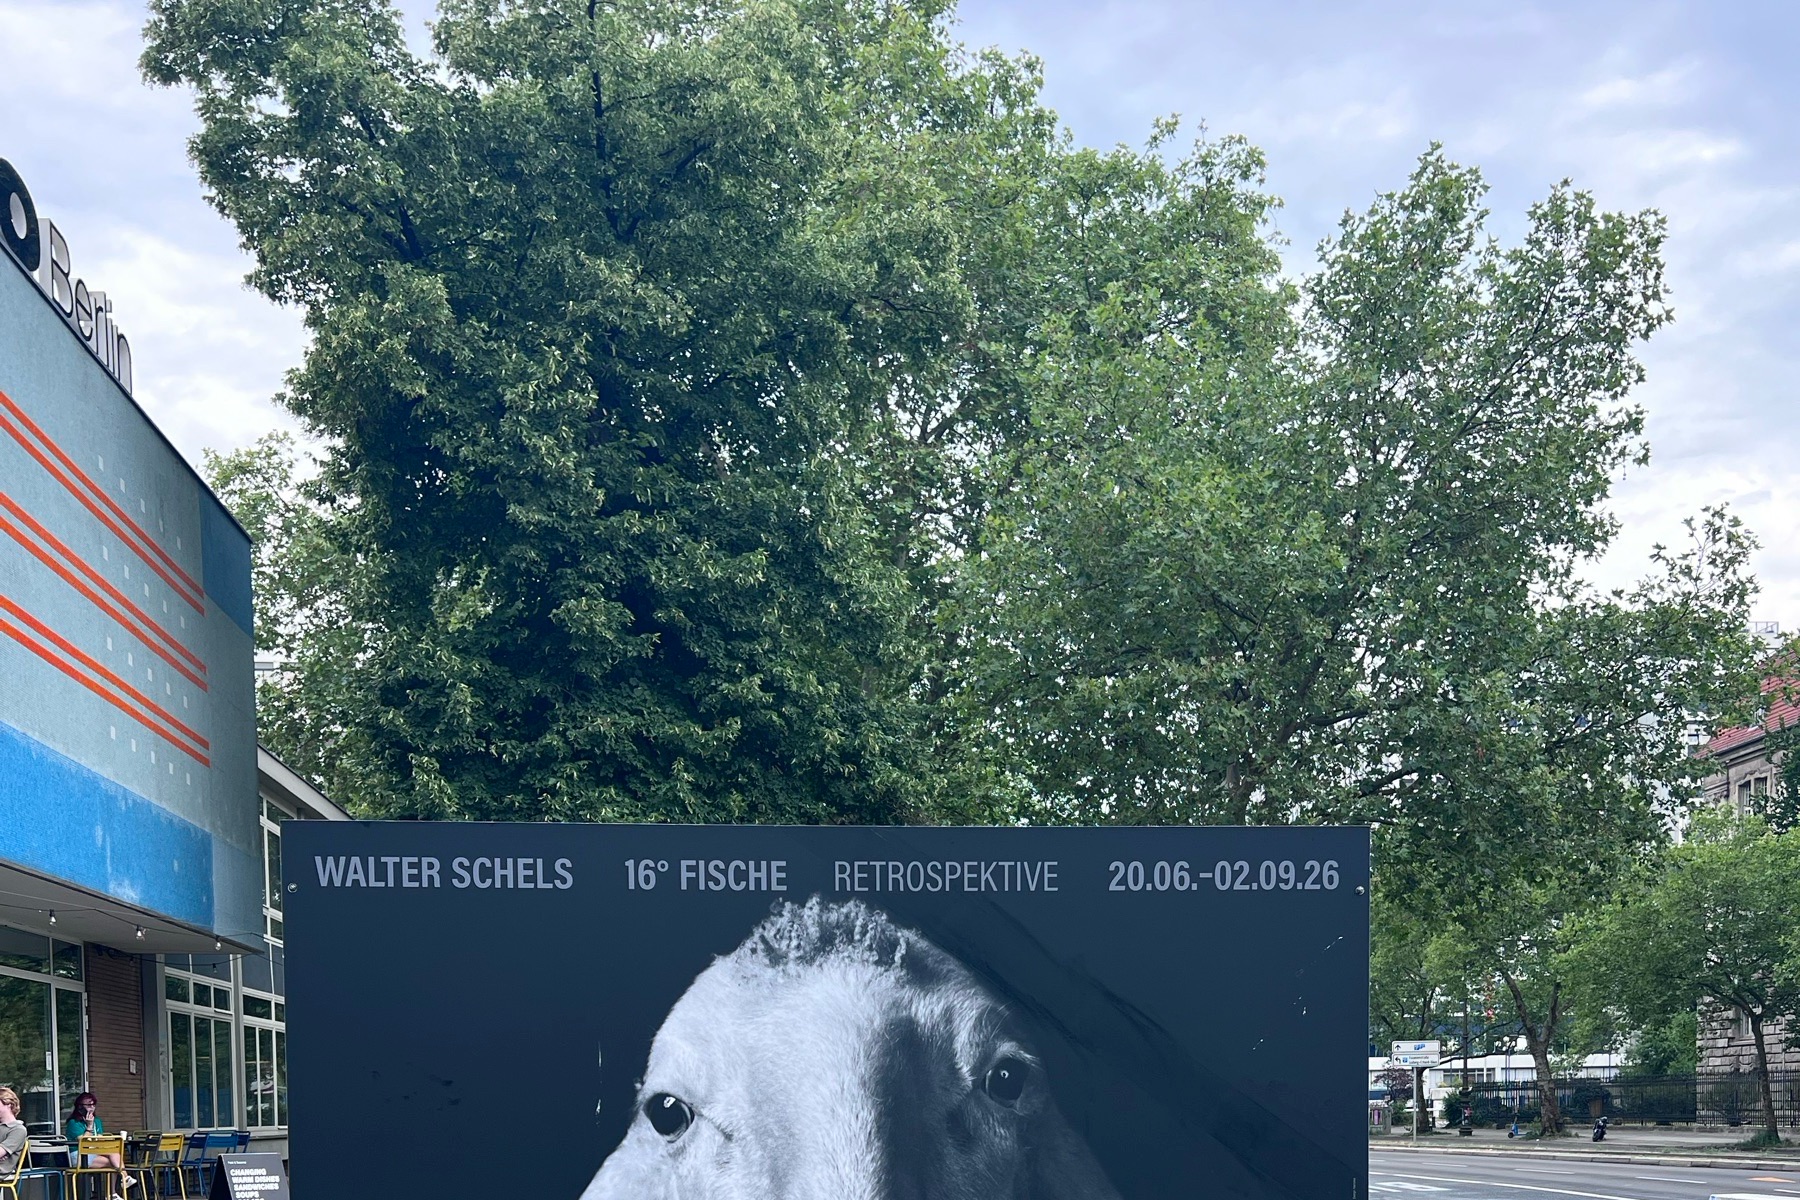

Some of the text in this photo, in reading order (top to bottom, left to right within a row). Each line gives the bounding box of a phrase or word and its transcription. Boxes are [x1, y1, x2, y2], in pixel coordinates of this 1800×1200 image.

[39, 218, 132, 395] Berlin
[314, 856, 440, 888] WALTER
[451, 857, 574, 889] SCHELS
[624, 859, 669, 890] 16°
[680, 859, 788, 891] FISCHE
[834, 861, 1059, 892] RETROSPEKTIVE
[230, 1168, 266, 1176] CHANGING
[254, 1175, 280, 1183] DISHES
[234, 1183, 279, 1191] SANDWICHES
